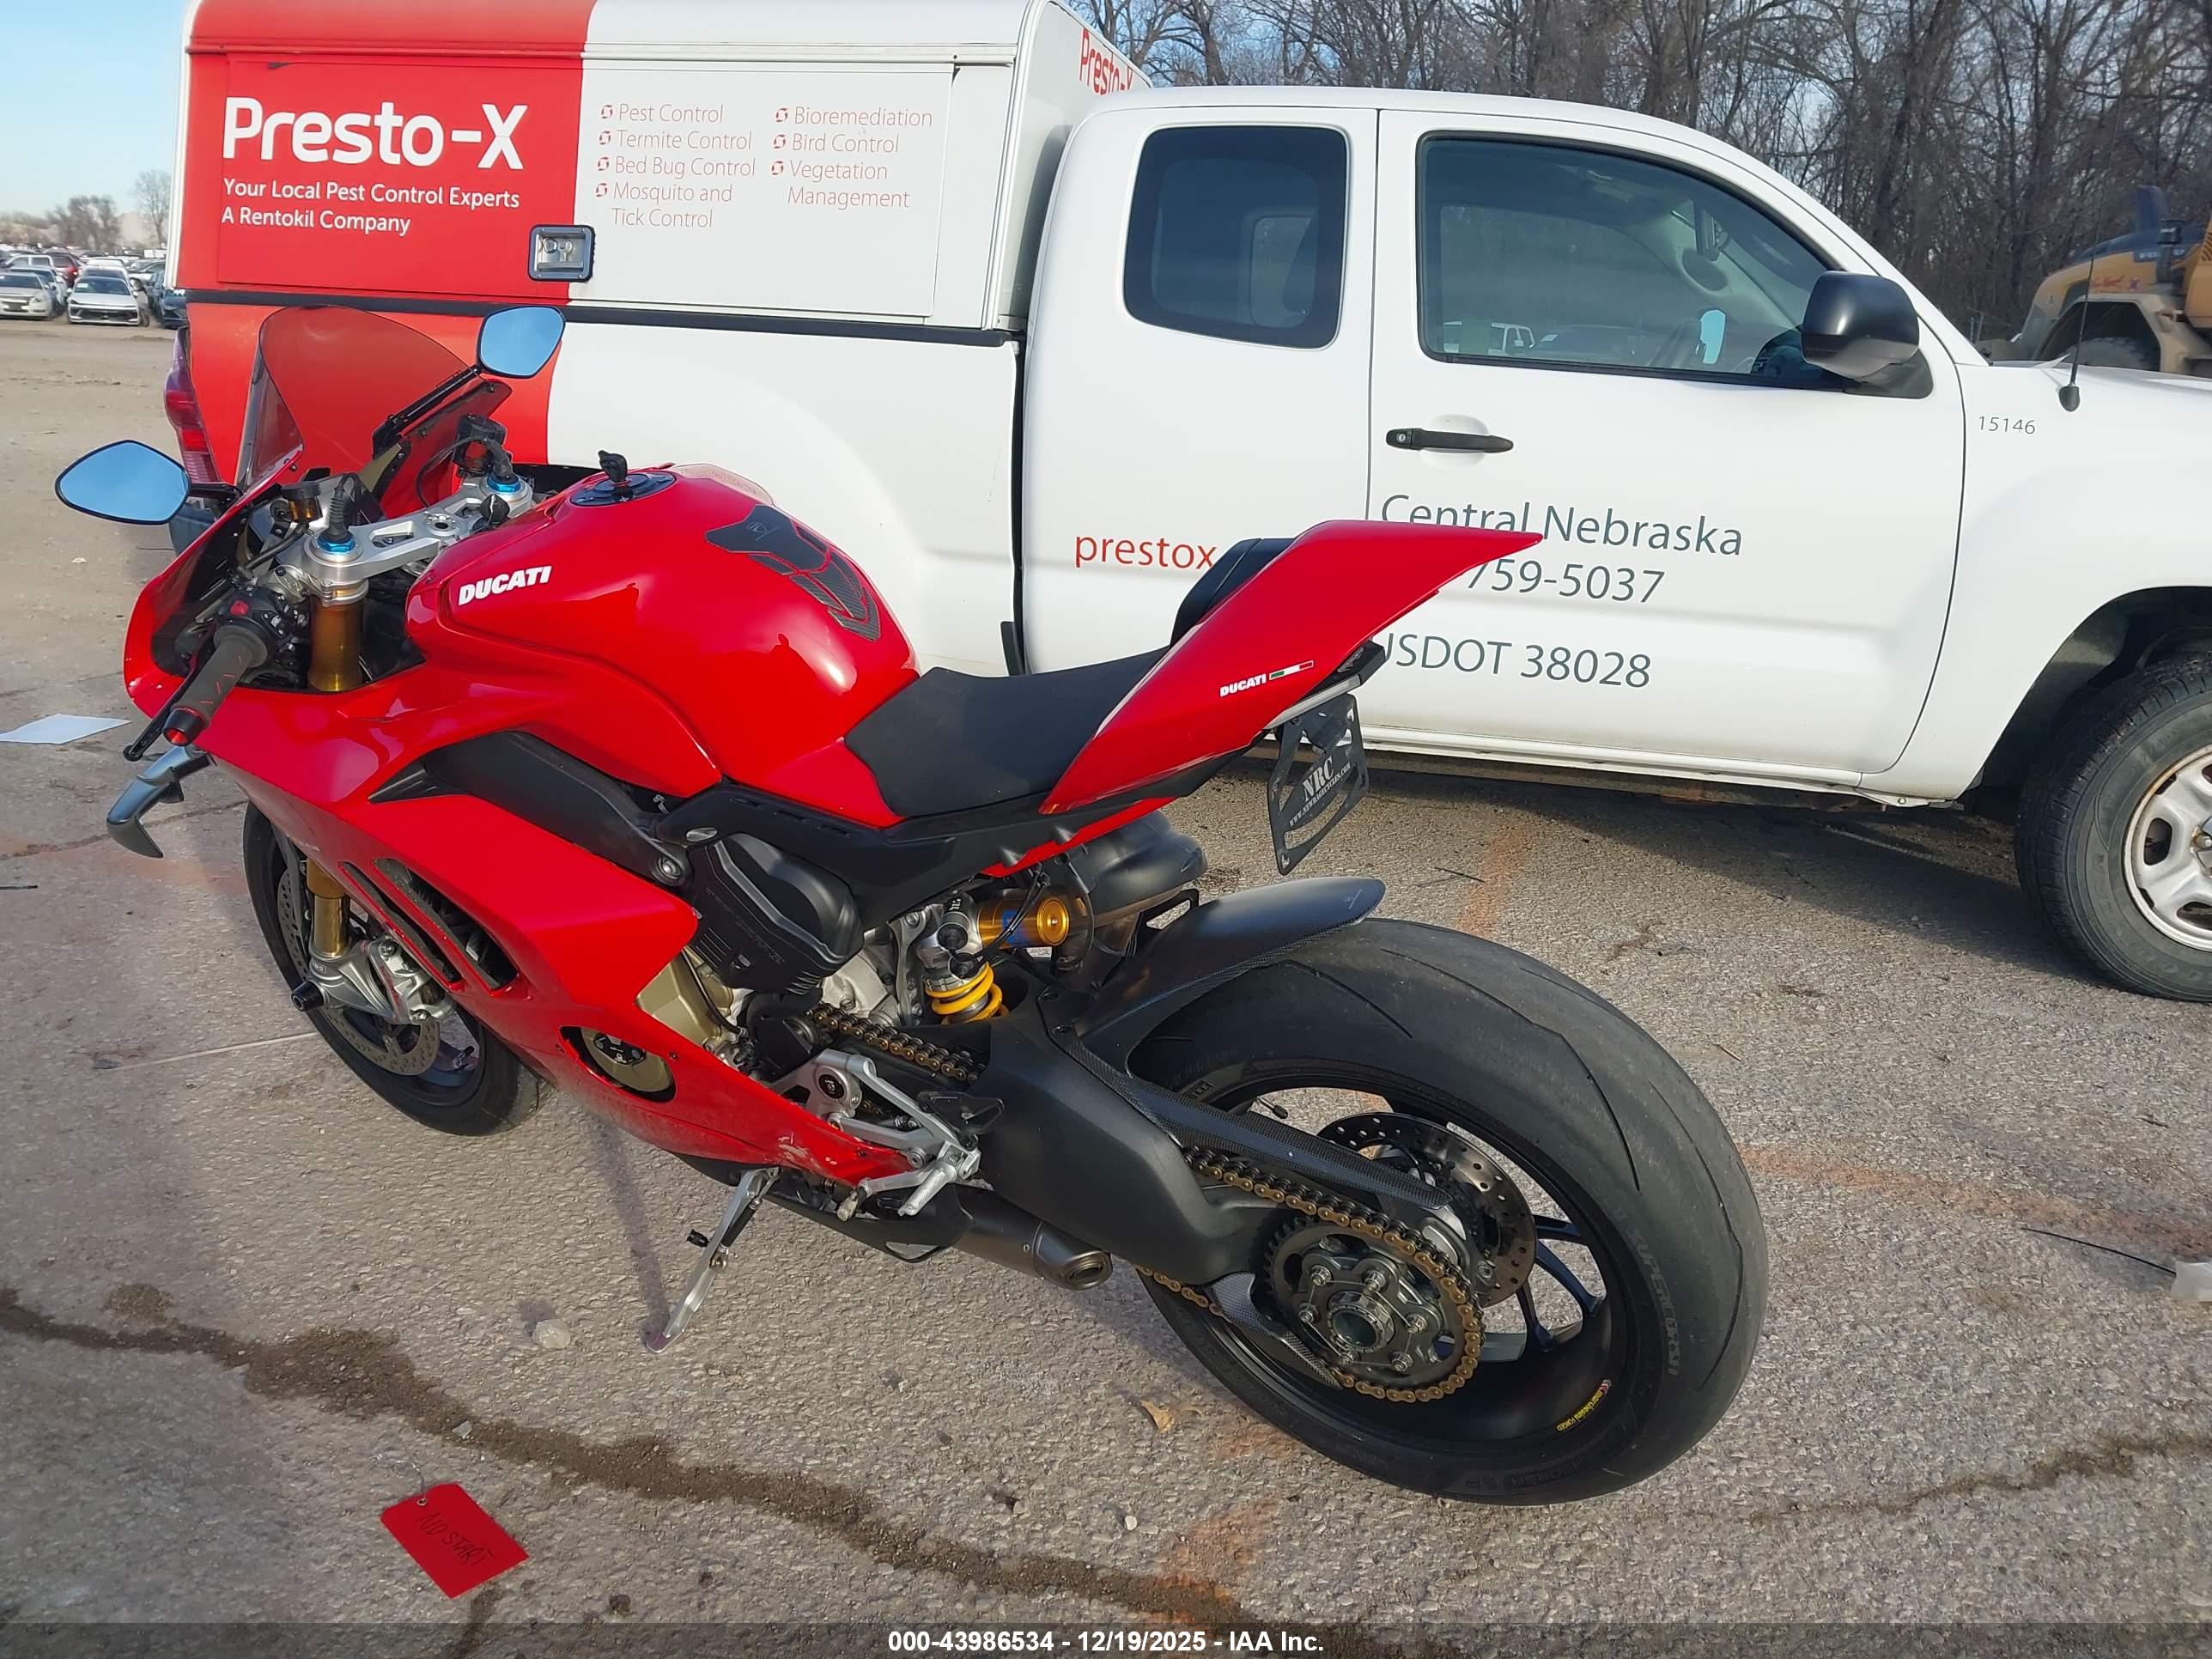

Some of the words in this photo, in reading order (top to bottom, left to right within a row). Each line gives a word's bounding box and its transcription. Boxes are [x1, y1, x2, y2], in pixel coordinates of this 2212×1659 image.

[618, 103, 654, 122] Pest
[659, 104, 723, 123] Control
[794, 106, 933, 127] Bioremediation
[222, 96, 527, 170] Presto-X
[617, 130, 682, 149] Termite
[687, 131, 752, 150] Control
[792, 133, 826, 151] Bird
[831, 133, 899, 153] Control
[615, 155, 647, 175] Bed
[653, 157, 685, 179] Bug
[690, 157, 756, 177] Control
[790, 160, 887, 184] Vegetation
[224, 178, 265, 198] Your
[272, 181, 320, 199] Local
[326, 183, 365, 201] Pest
[371, 185, 443, 205] Control
[449, 187, 520, 211] Experts
[613, 183, 694, 206] Mosquito
[699, 184, 732, 203] and
[787, 186, 910, 210] Management
[222, 207, 234, 224] A
[240, 207, 314, 228] Rentokil
[319, 210, 410, 236] Company
[611, 208, 645, 226] Tick
[648, 208, 713, 228] Control
[1979, 416, 2035, 434] 15146
[1382, 495, 1530, 532] Central
[1544, 505, 1741, 556] Nebraska
[1074, 536, 1218, 570] prestox
[458, 565, 552, 606] DUCATI
[1521, 645, 1650, 688] 38028
[1219, 673, 1267, 697] DUCATI
[1302, 757, 1334, 802] NRC
